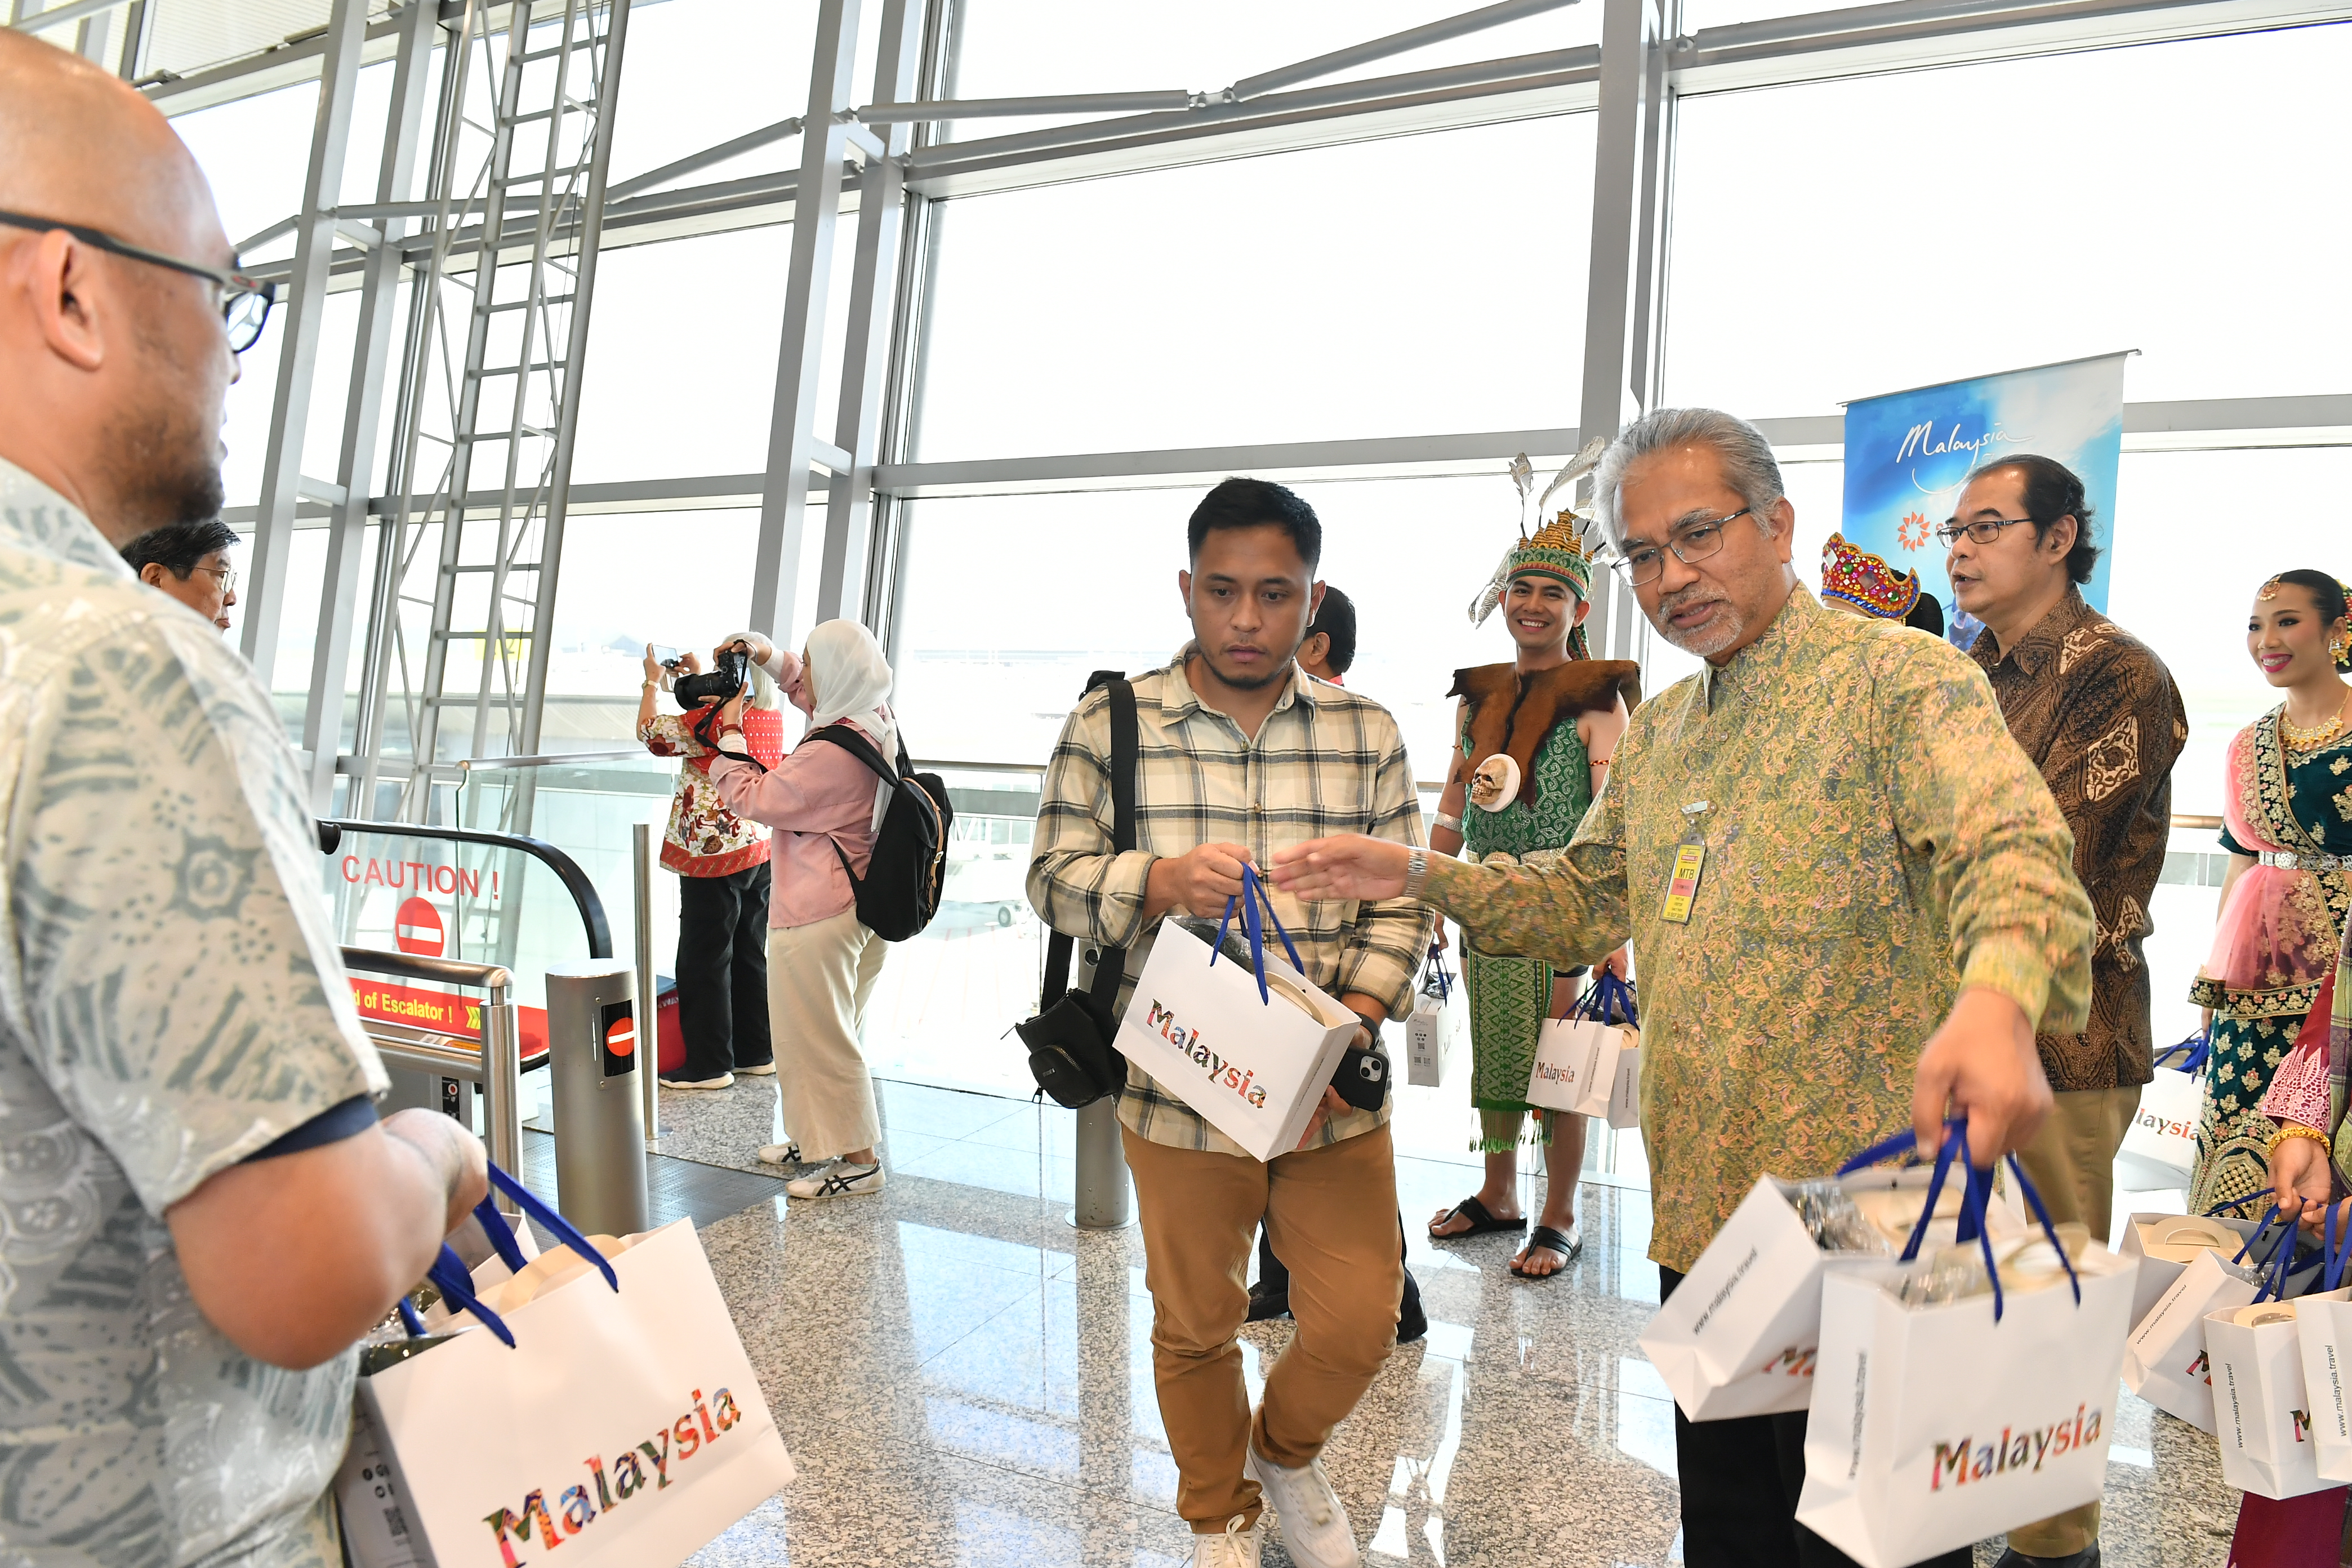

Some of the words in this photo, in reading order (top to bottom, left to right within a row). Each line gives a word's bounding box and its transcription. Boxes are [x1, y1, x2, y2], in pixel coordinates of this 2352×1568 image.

[1896, 420, 2035, 495] Malaysia
[342, 855, 478, 897] CAUTION
[493, 871, 498, 899] !
[1678, 868, 1695, 879] MTB
[364, 991, 377, 1009] of
[382, 994, 444, 1021] Escalator
[448, 1005, 453, 1023] !
[1147, 998, 1267, 1109] Malaysia
[1535, 1061, 1576, 1085] Malaysia
[2136, 1107, 2199, 1141] laysia
[2136, 1284, 2187, 1345] www.malaysia.travel
[2225, 1363, 2243, 1449] www.malaysia.travel
[2324, 1345, 2347, 1437] www.malaysia.travel
[482, 1387, 741, 1568] Malaysia
[1931, 1401, 2102, 1491] Malaysia
